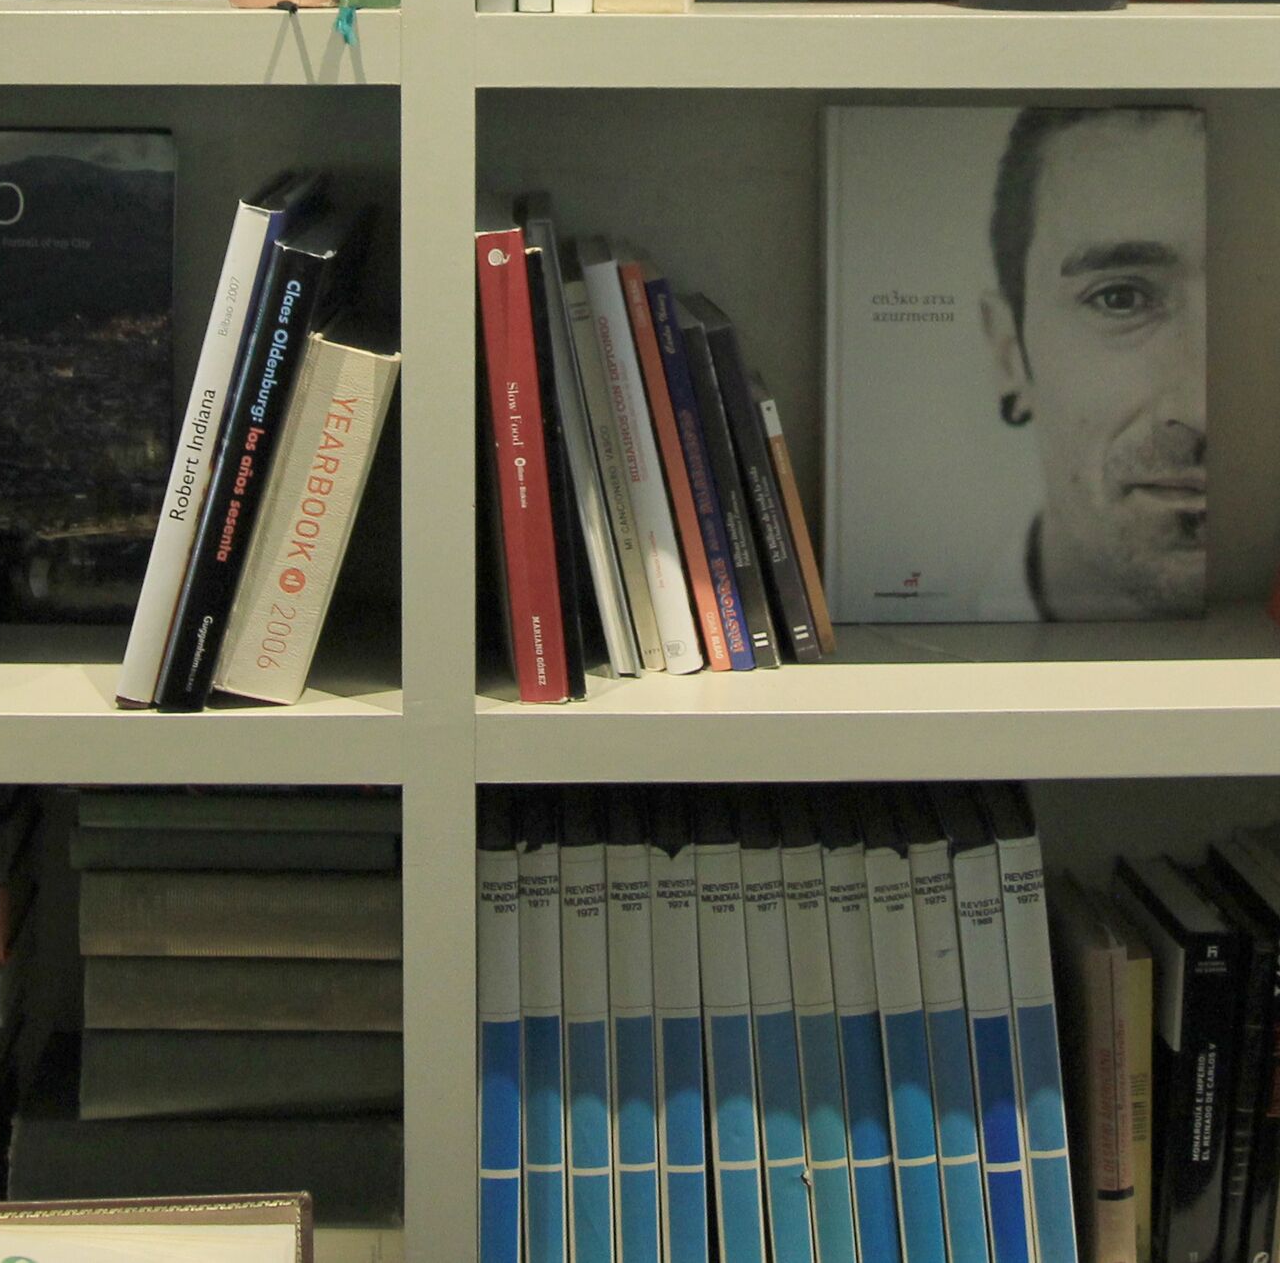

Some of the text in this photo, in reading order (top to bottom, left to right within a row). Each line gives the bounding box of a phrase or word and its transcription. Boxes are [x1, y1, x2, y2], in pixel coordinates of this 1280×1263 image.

[168, 389, 216, 520] Robert Indiana
[215, 280, 300, 563] Claes Oldenburg: los años sesenta
[506, 381, 524, 446] Slow Food
[256, 392, 357, 671] YEARBOOK 2006
[701, 892, 741, 903] MUNDIAL
[702, 881, 740, 892] REVISTA
